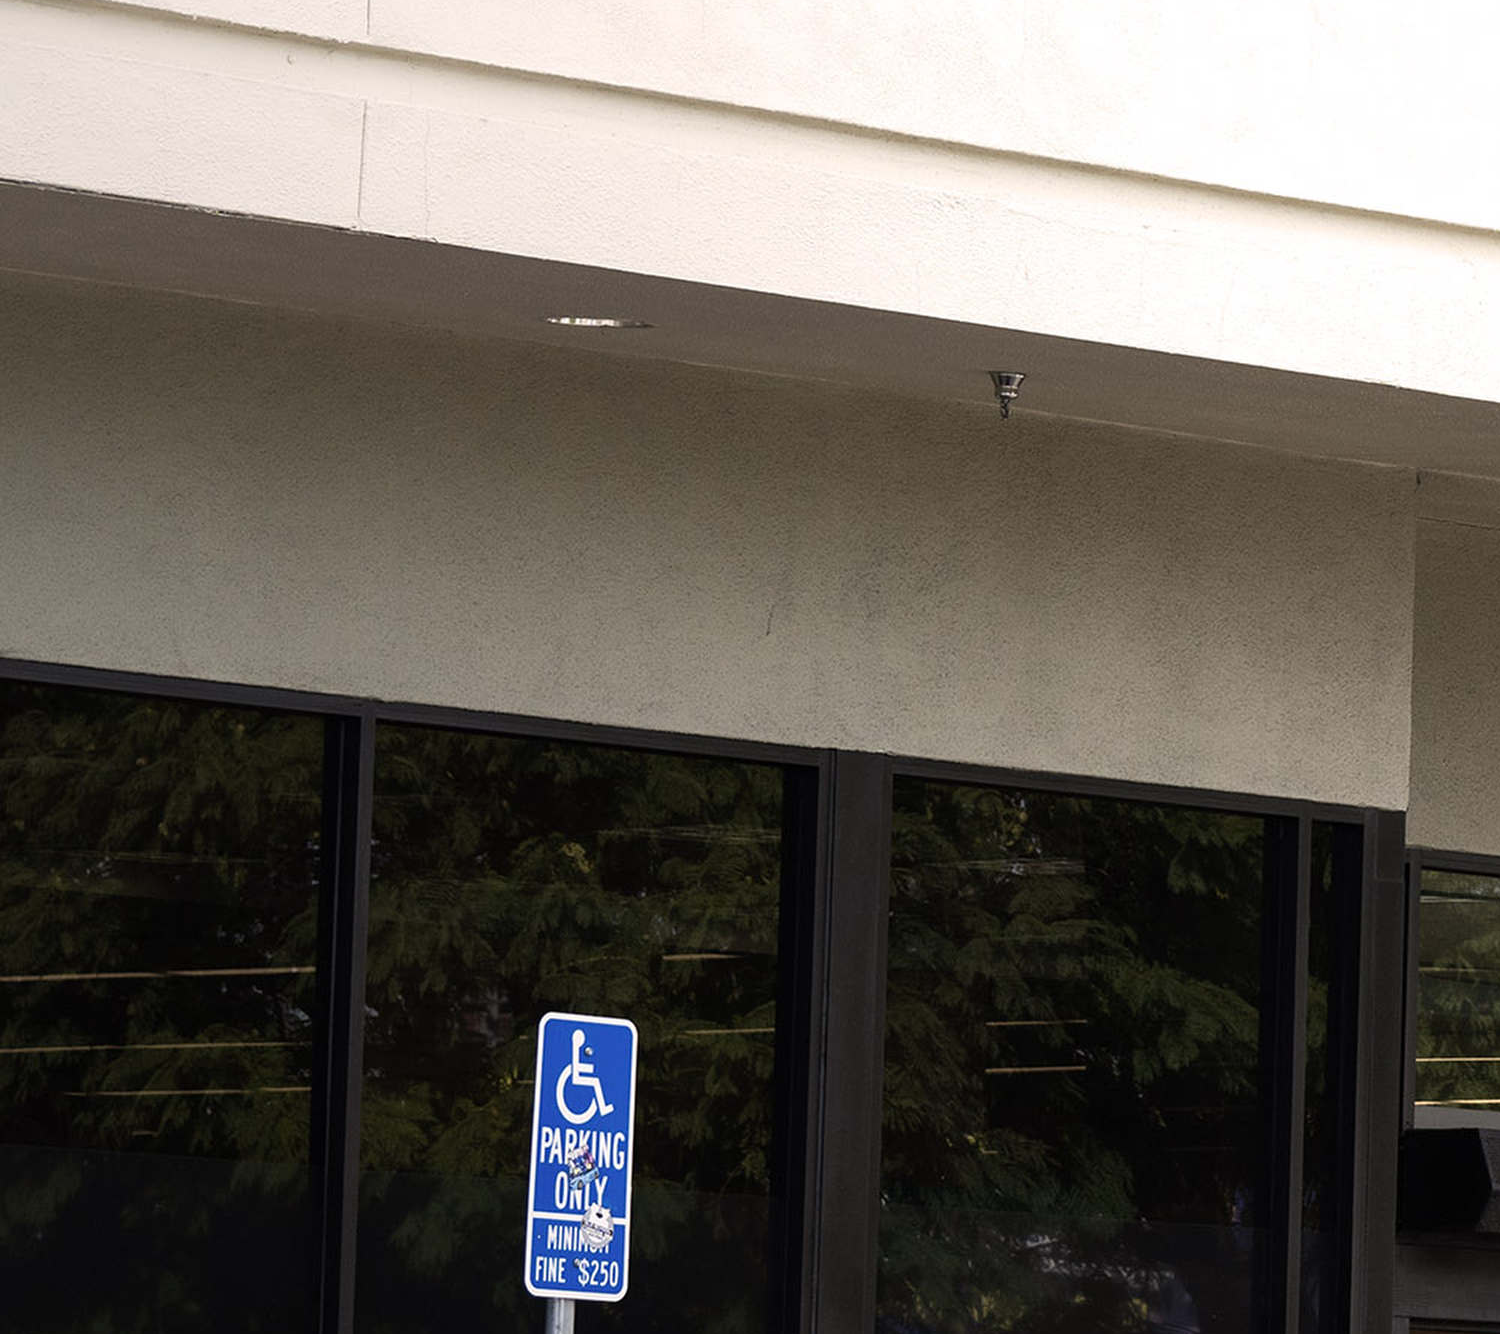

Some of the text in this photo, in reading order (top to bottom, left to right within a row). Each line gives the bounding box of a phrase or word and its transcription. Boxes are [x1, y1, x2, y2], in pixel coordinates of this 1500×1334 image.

[547, 1225, 609, 1254] MINI
[535, 1256, 619, 1288] FINE $250
